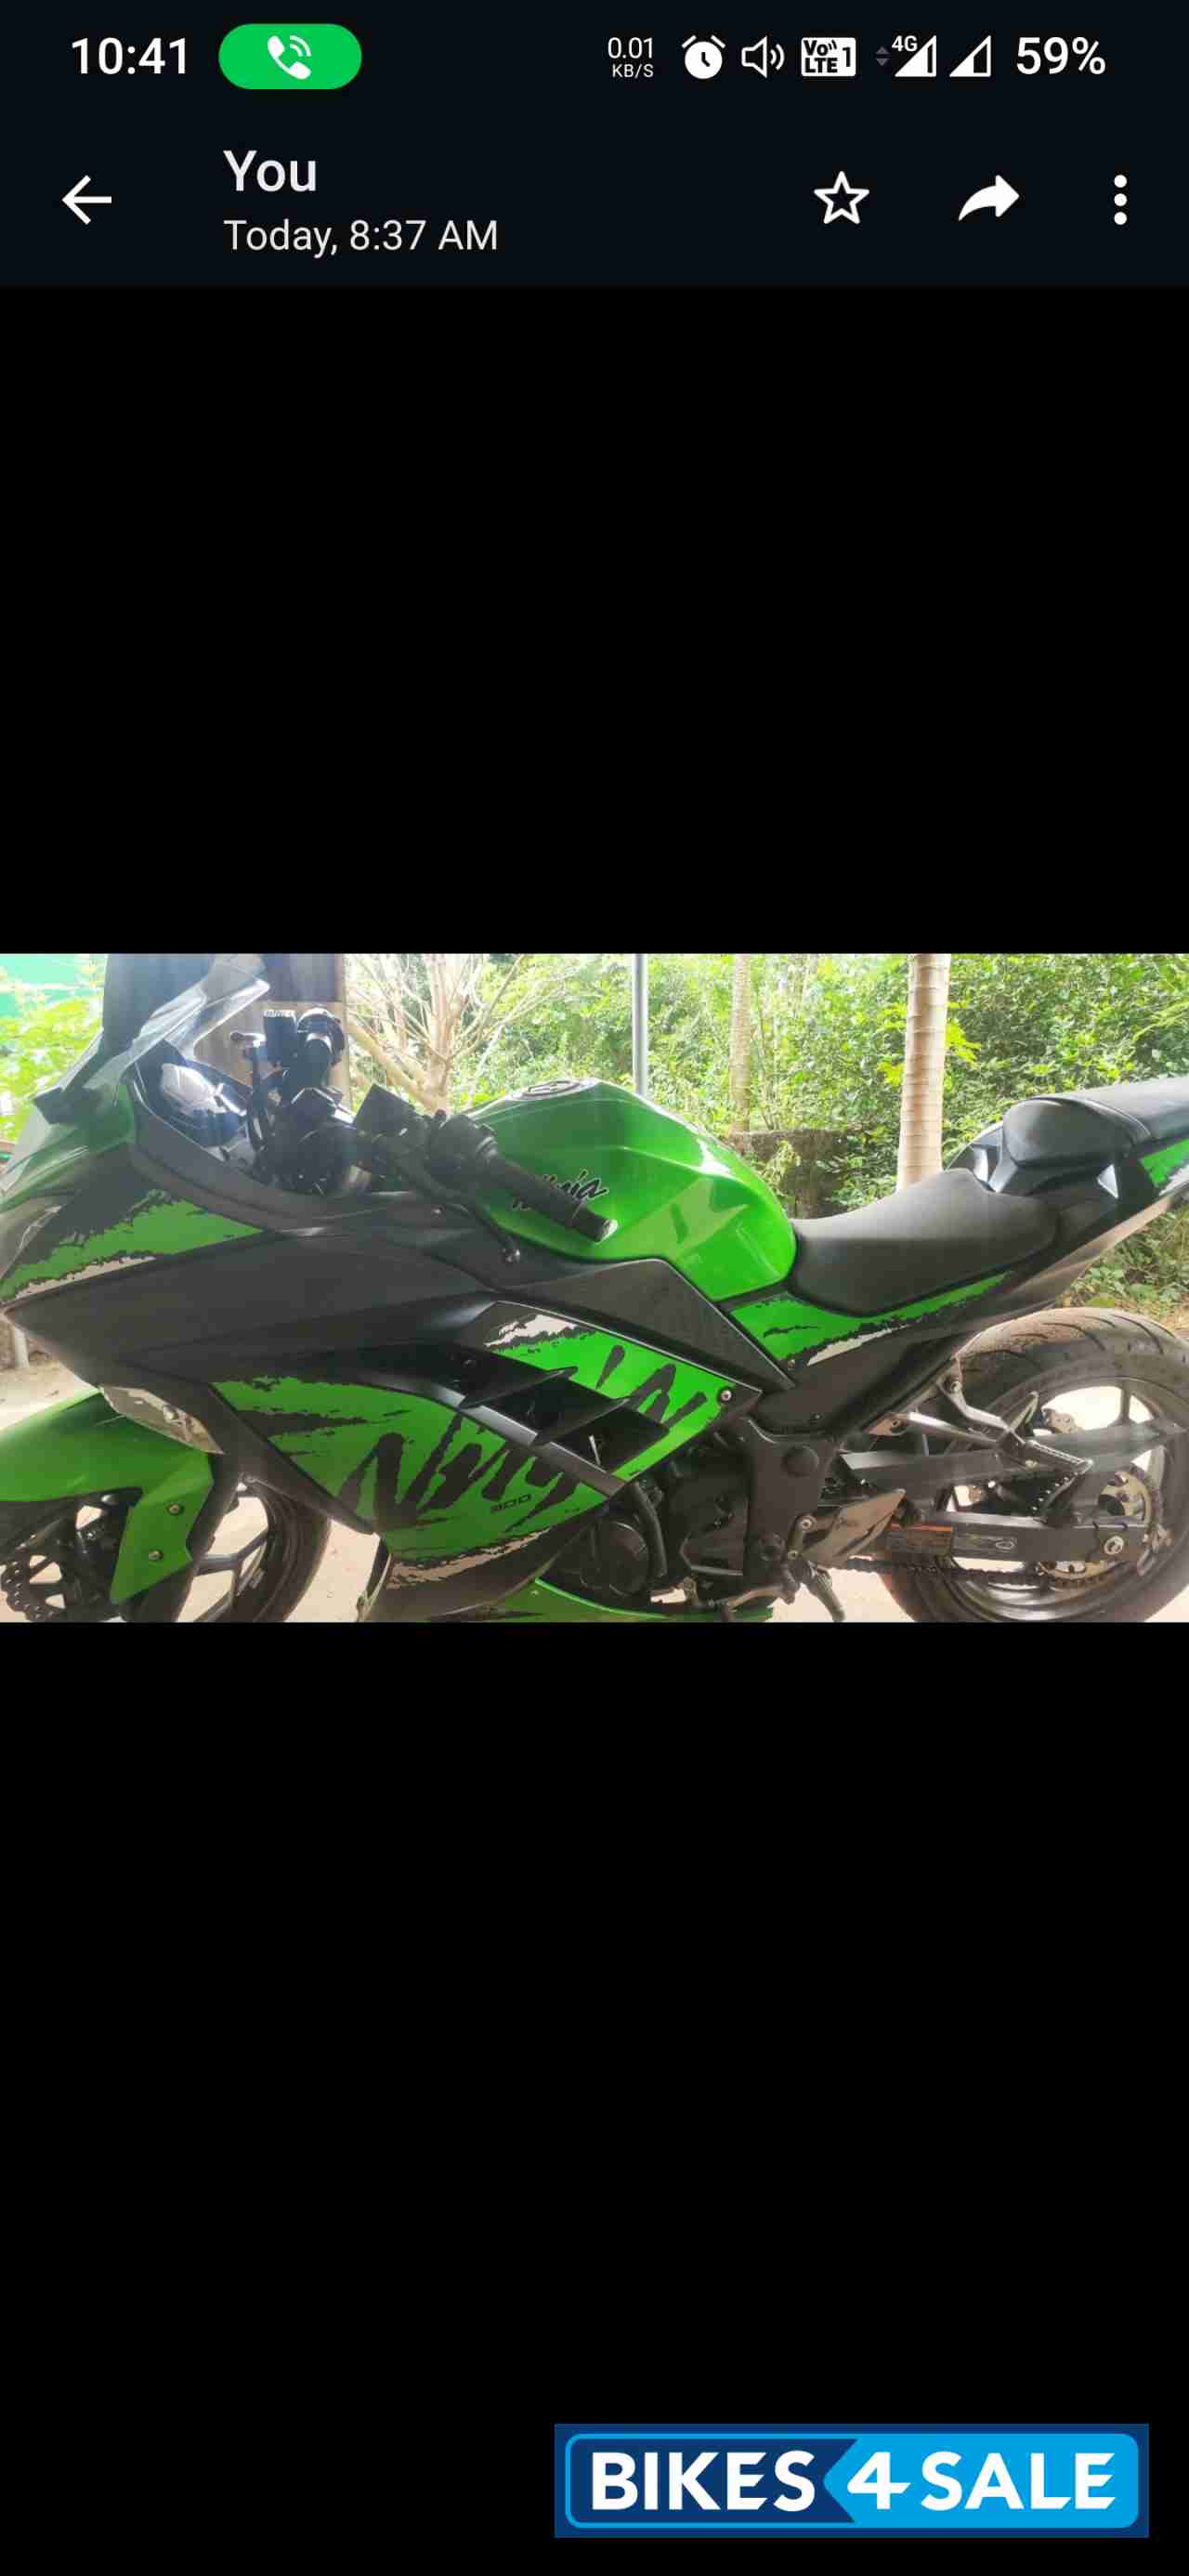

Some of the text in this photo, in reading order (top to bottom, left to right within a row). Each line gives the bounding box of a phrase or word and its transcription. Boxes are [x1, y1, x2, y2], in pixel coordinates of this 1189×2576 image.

[608, 36, 654, 59] 0.01
[804, 40, 828, 57] Vo
[891, 34, 918, 53] 4G
[72, 37, 187, 75] 10:41
[804, 57, 838, 73] LTE
[842, 46, 852, 68] 1
[1016, 36, 1106, 75] 59%
[612, 64, 654, 79] KB/S
[223, 150, 317, 192] You
[223, 218, 498, 259] Today, 8:37 AM
